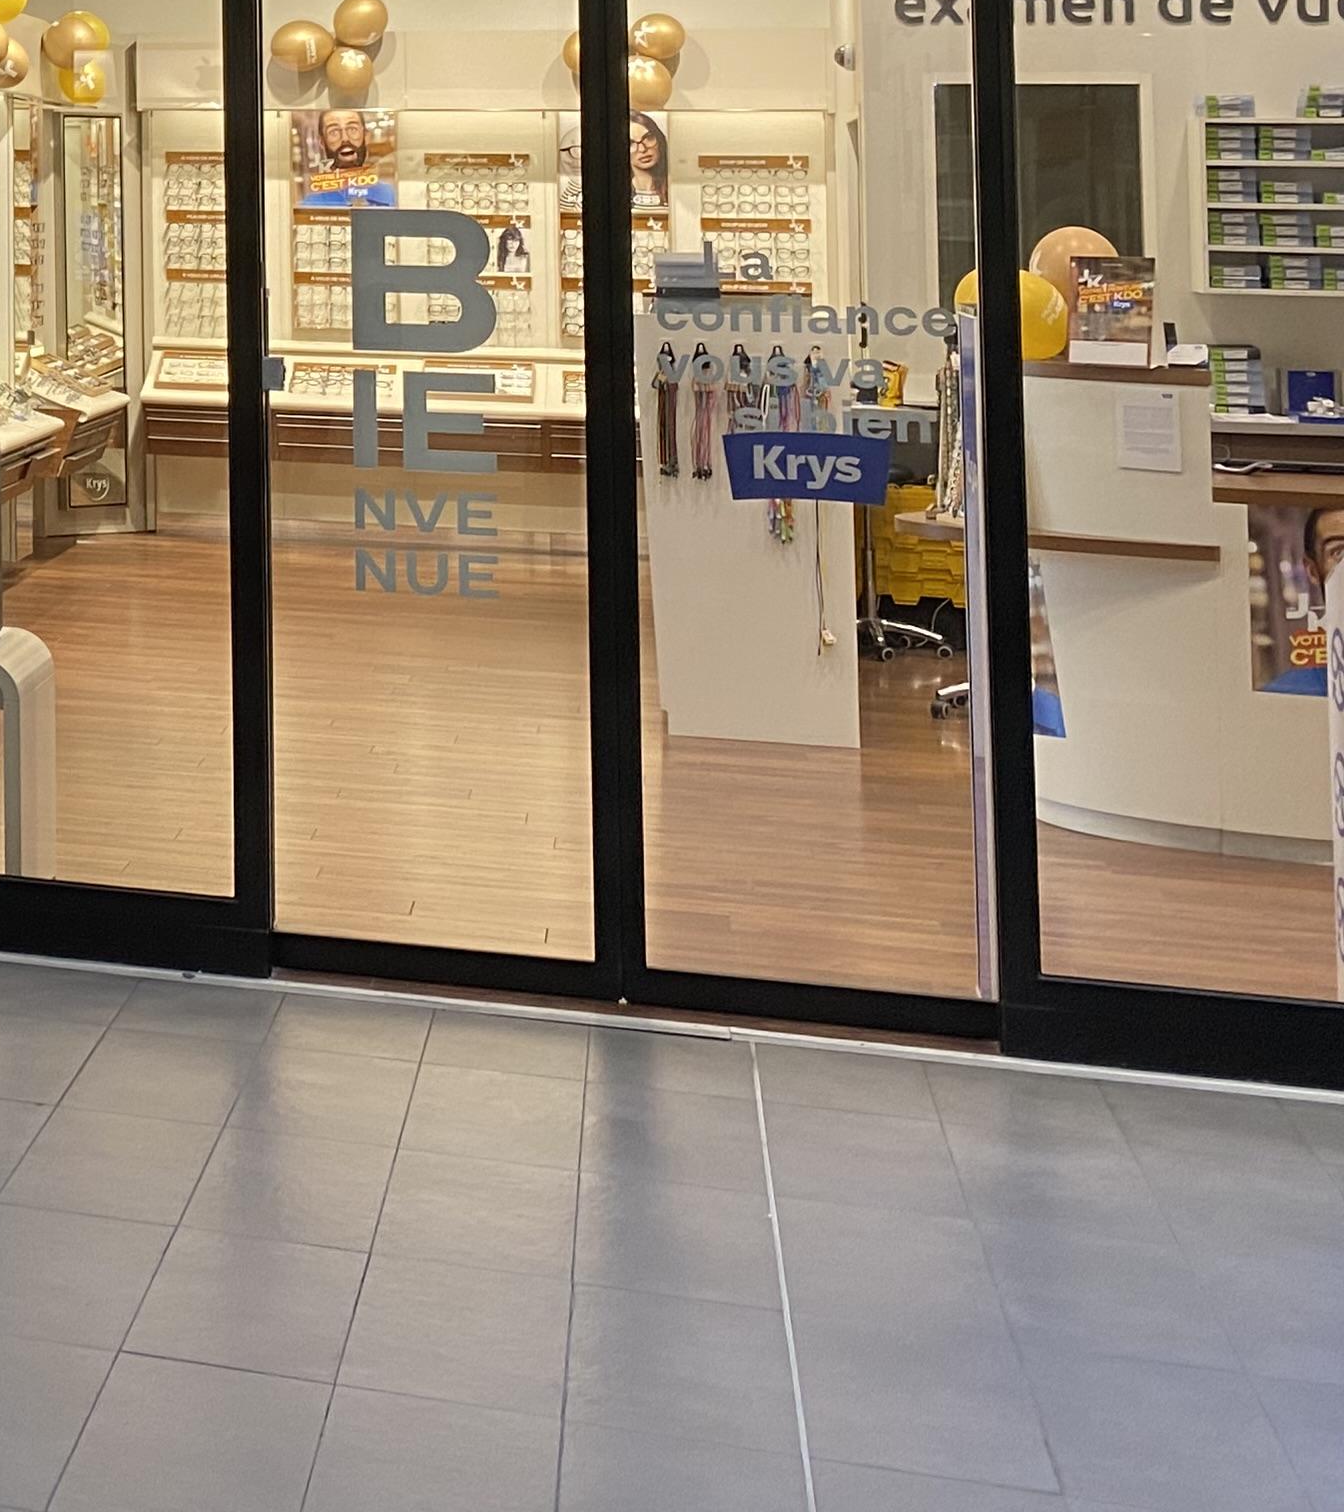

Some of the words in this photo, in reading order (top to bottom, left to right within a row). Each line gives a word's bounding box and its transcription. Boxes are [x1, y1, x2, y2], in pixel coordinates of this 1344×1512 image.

[348, 174, 379, 187] KDO
[352, 209, 497, 353] B
[655, 294, 959, 338] confiance
[657, 354, 797, 389] vous
[816, 357, 889, 389] va
[353, 369, 498, 473] IE
[86, 478, 107, 492] Krys
[753, 444, 863, 490] Krys
[355, 490, 499, 537] NVE
[355, 548, 500, 599] NUE
